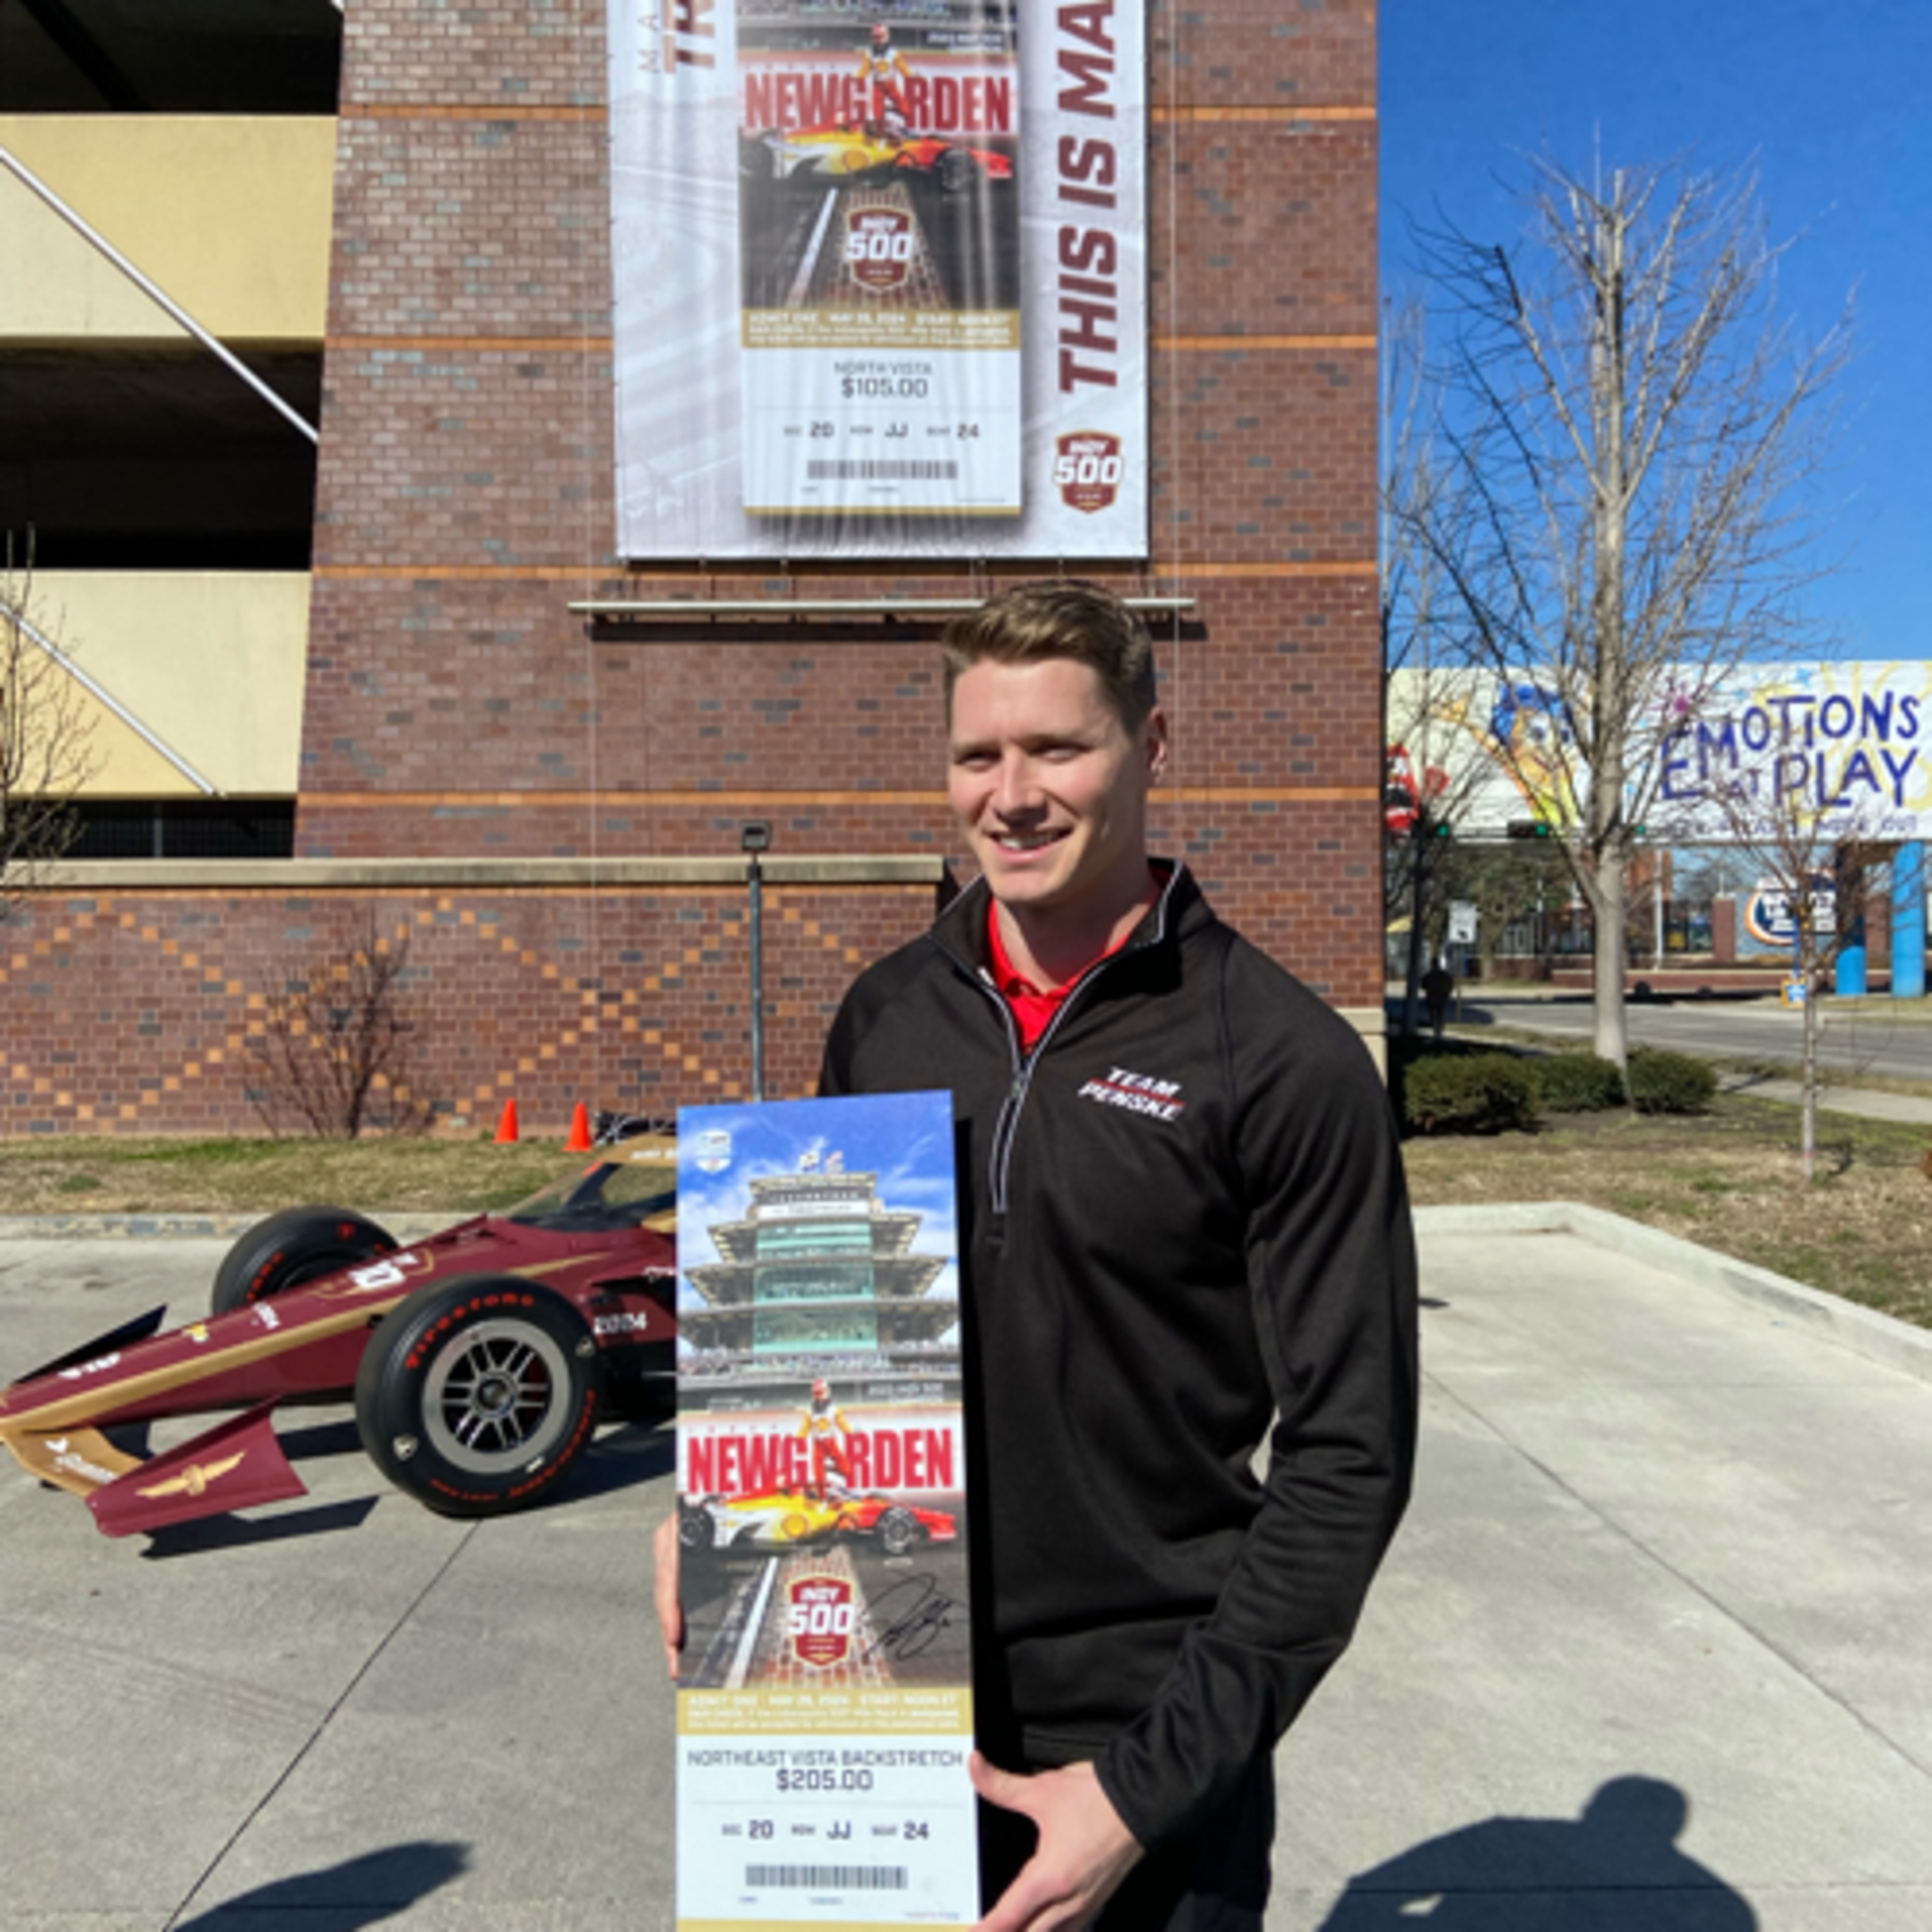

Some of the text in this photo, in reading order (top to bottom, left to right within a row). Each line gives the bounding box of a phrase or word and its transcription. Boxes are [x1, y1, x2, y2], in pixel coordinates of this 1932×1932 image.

[744, 71, 1010, 132] NEWGRDEN
[1057, 135, 1116, 209] IS
[846, 232, 914, 260] 500
[1057, 224, 1117, 394] THIS
[835, 362, 933, 376] NORTH VISTA
[841, 377, 929, 399] $105.00
[884, 422, 909, 439] JJ
[956, 424, 980, 440] 24
[1053, 455, 1122, 484] 500
[1660, 690, 1921, 800] EMOTIONS
[1774, 748, 1918, 808] PLAY
[1106, 1066, 1181, 1097] TEAM
[1077, 1081, 1184, 1122] PENSKE
[404, 1292, 535, 1370] Firestone
[687, 1428, 954, 1495] NEWGRDEN
[799, 1587, 840, 1602] INDY
[788, 1604, 855, 1634] 500
[687, 1749, 963, 1766] NORTHEAST VISTA BACKSTRETCH
[777, 1768, 874, 1792] $205.00
[748, 1819, 774, 1839] 20
[826, 1819, 852, 1840] JJ
[903, 1821, 930, 1841] 24
